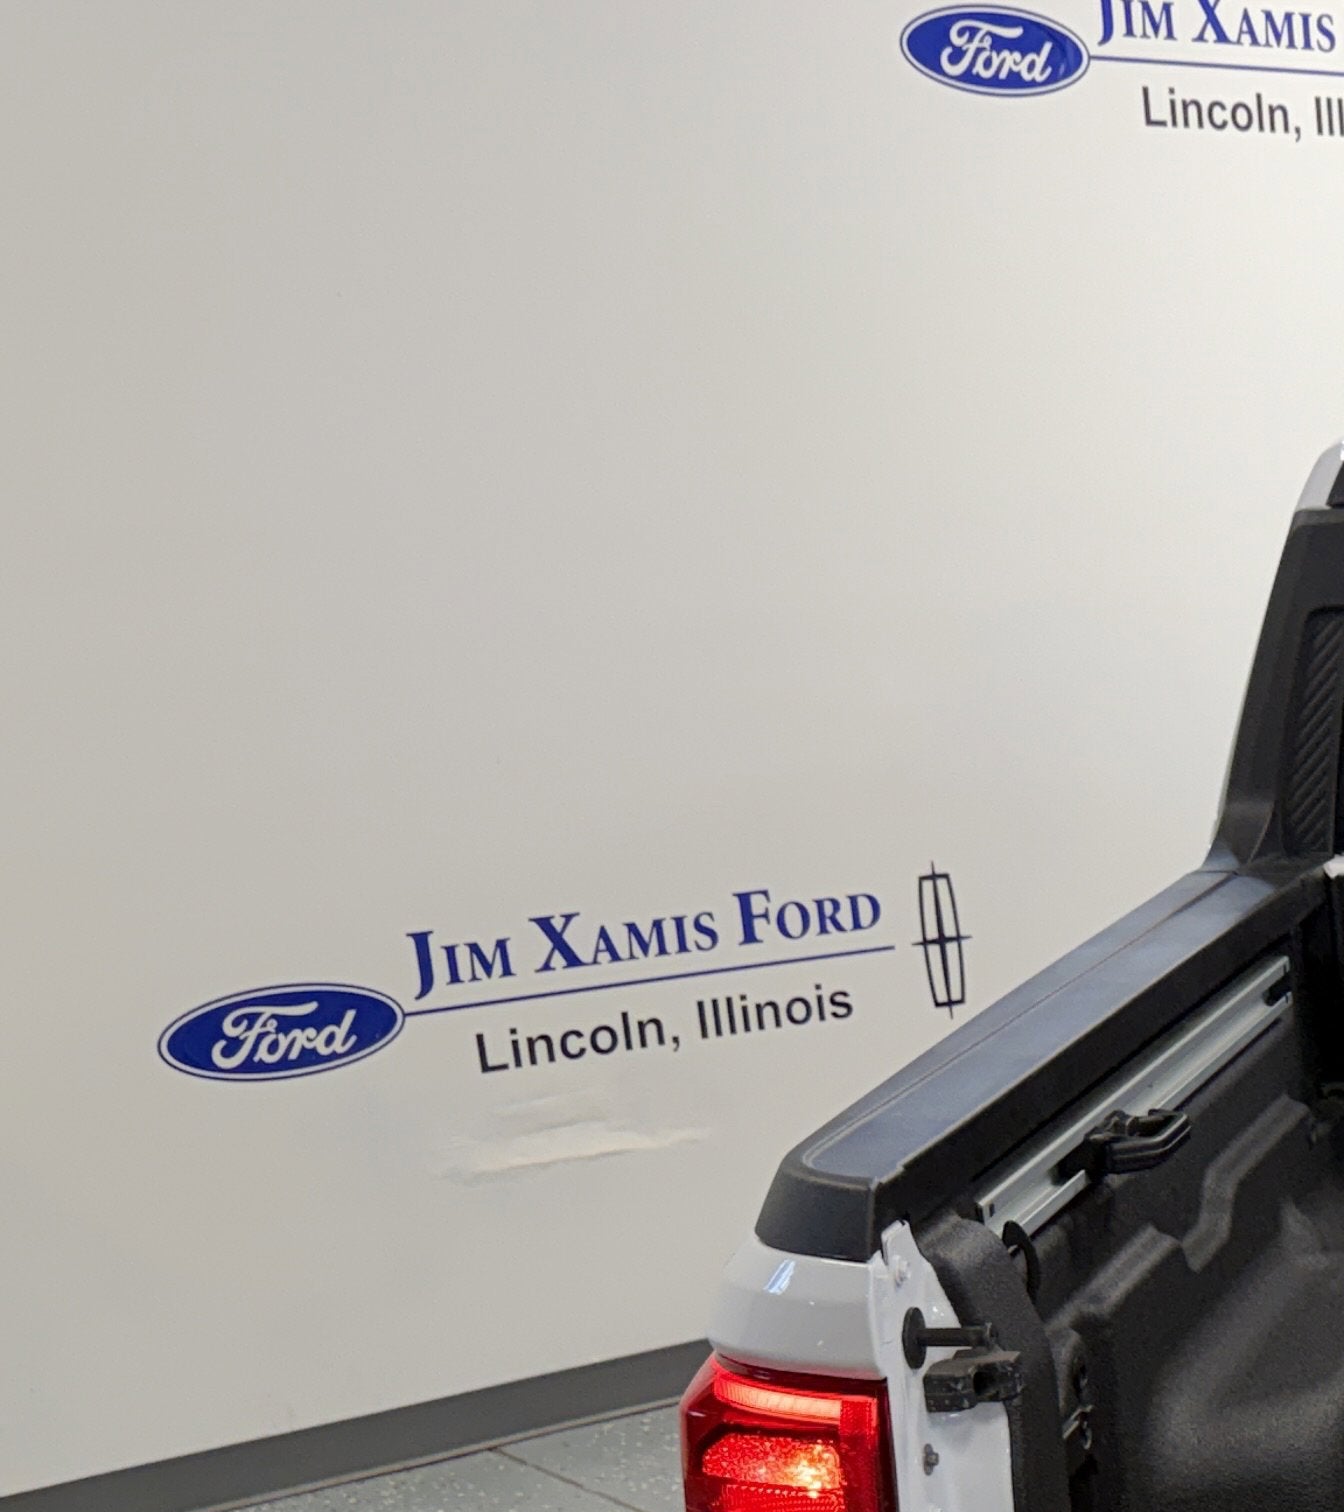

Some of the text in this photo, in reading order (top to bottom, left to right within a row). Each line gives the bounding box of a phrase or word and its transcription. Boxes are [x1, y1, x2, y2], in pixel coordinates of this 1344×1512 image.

[940, 19, 1053, 84] Ford
[1097, 0, 1177, 46] JIM
[1191, 0, 1336, 53] XAMIS
[1142, 86, 1301, 142] Lincoln,
[406, 889, 881, 1001] JIM XAMIS FORD
[211, 1001, 358, 1070] Ford
[476, 983, 854, 1075] Lincoln, Illinois
